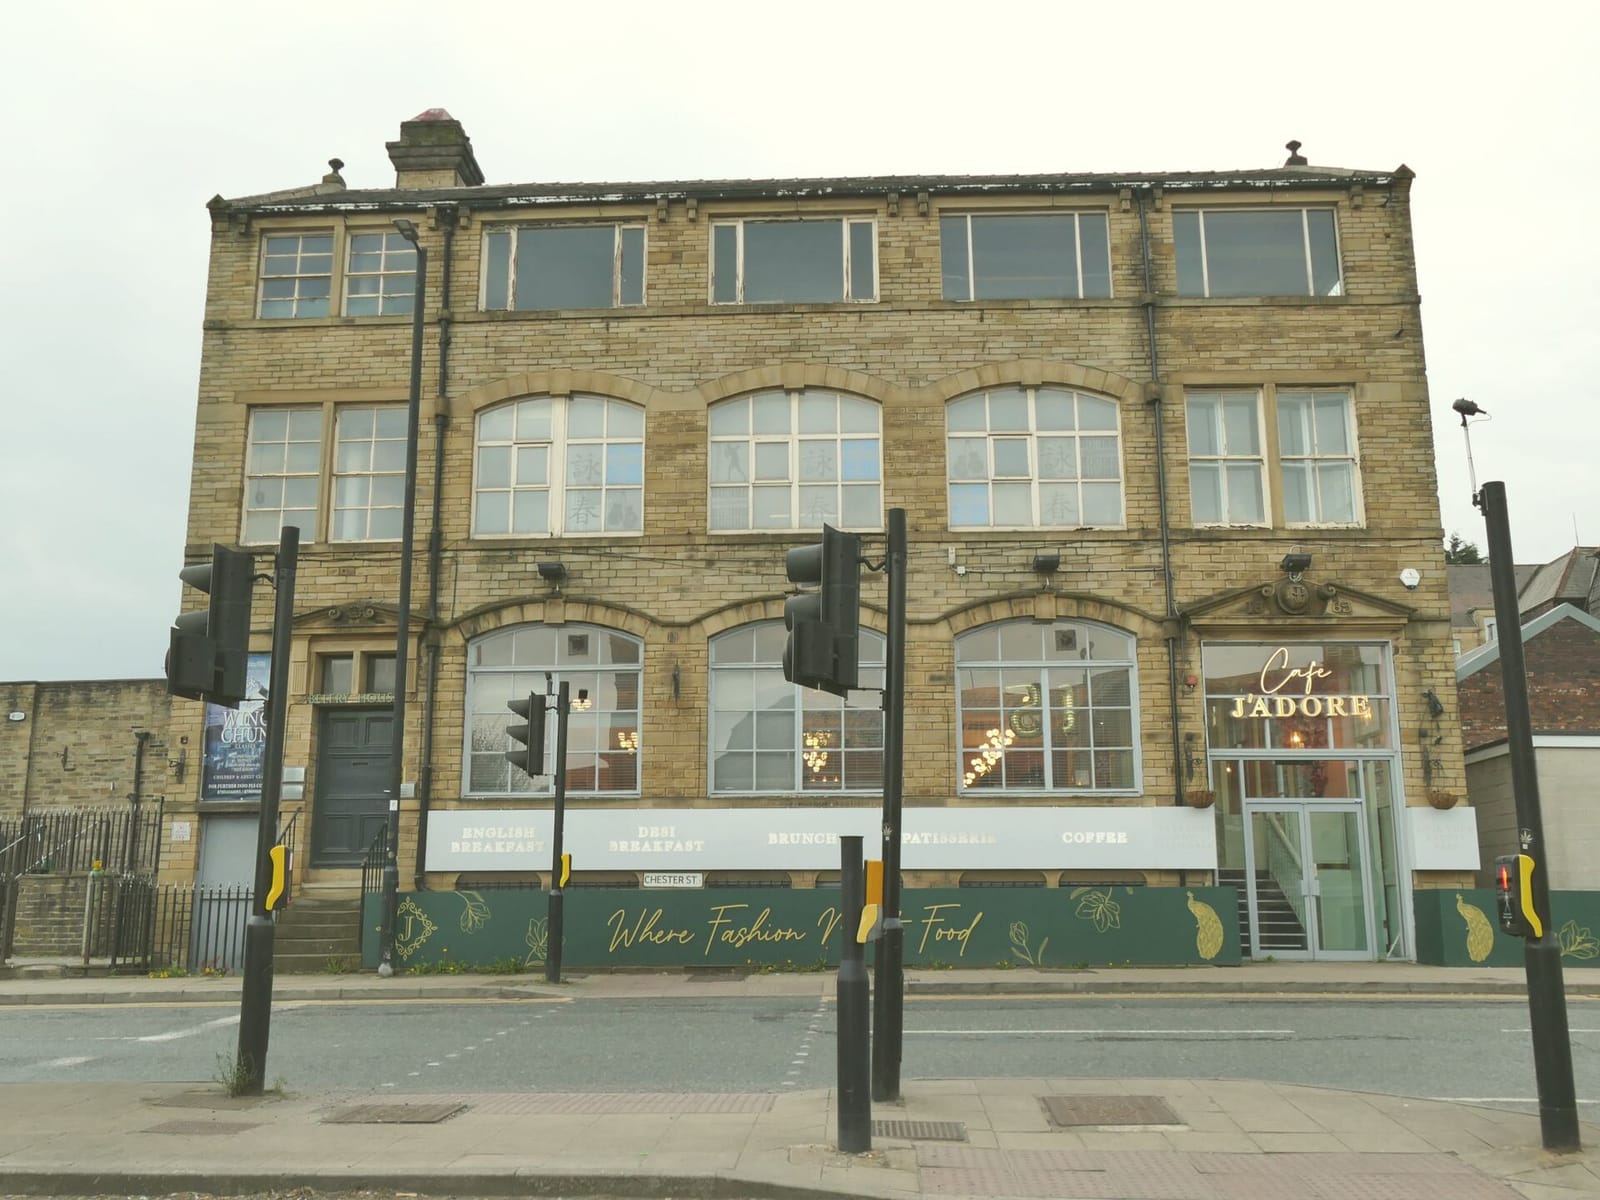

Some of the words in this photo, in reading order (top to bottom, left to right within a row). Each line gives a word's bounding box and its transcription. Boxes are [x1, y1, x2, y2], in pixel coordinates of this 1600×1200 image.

[1260, 647, 1332, 694] Cafe
[357, 691, 396, 704] HOUS
[1231, 693, 1370, 717] J'ADORE
[462, 826, 536, 839] ENGLISH
[638, 825, 676, 838] DESI
[1062, 831, 1128, 844] COFFEE
[767, 832, 839, 845] BRUNCH
[450, 840, 545, 853] BREAKFAST
[608, 839, 705, 852] BREAKFAST
[644, 874, 685, 885] CHESTER
[686, 874, 697, 885] ST
[607, 907, 695, 953] Where
[704, 903, 806, 956] Fashion
[918, 903, 983, 957] Food
